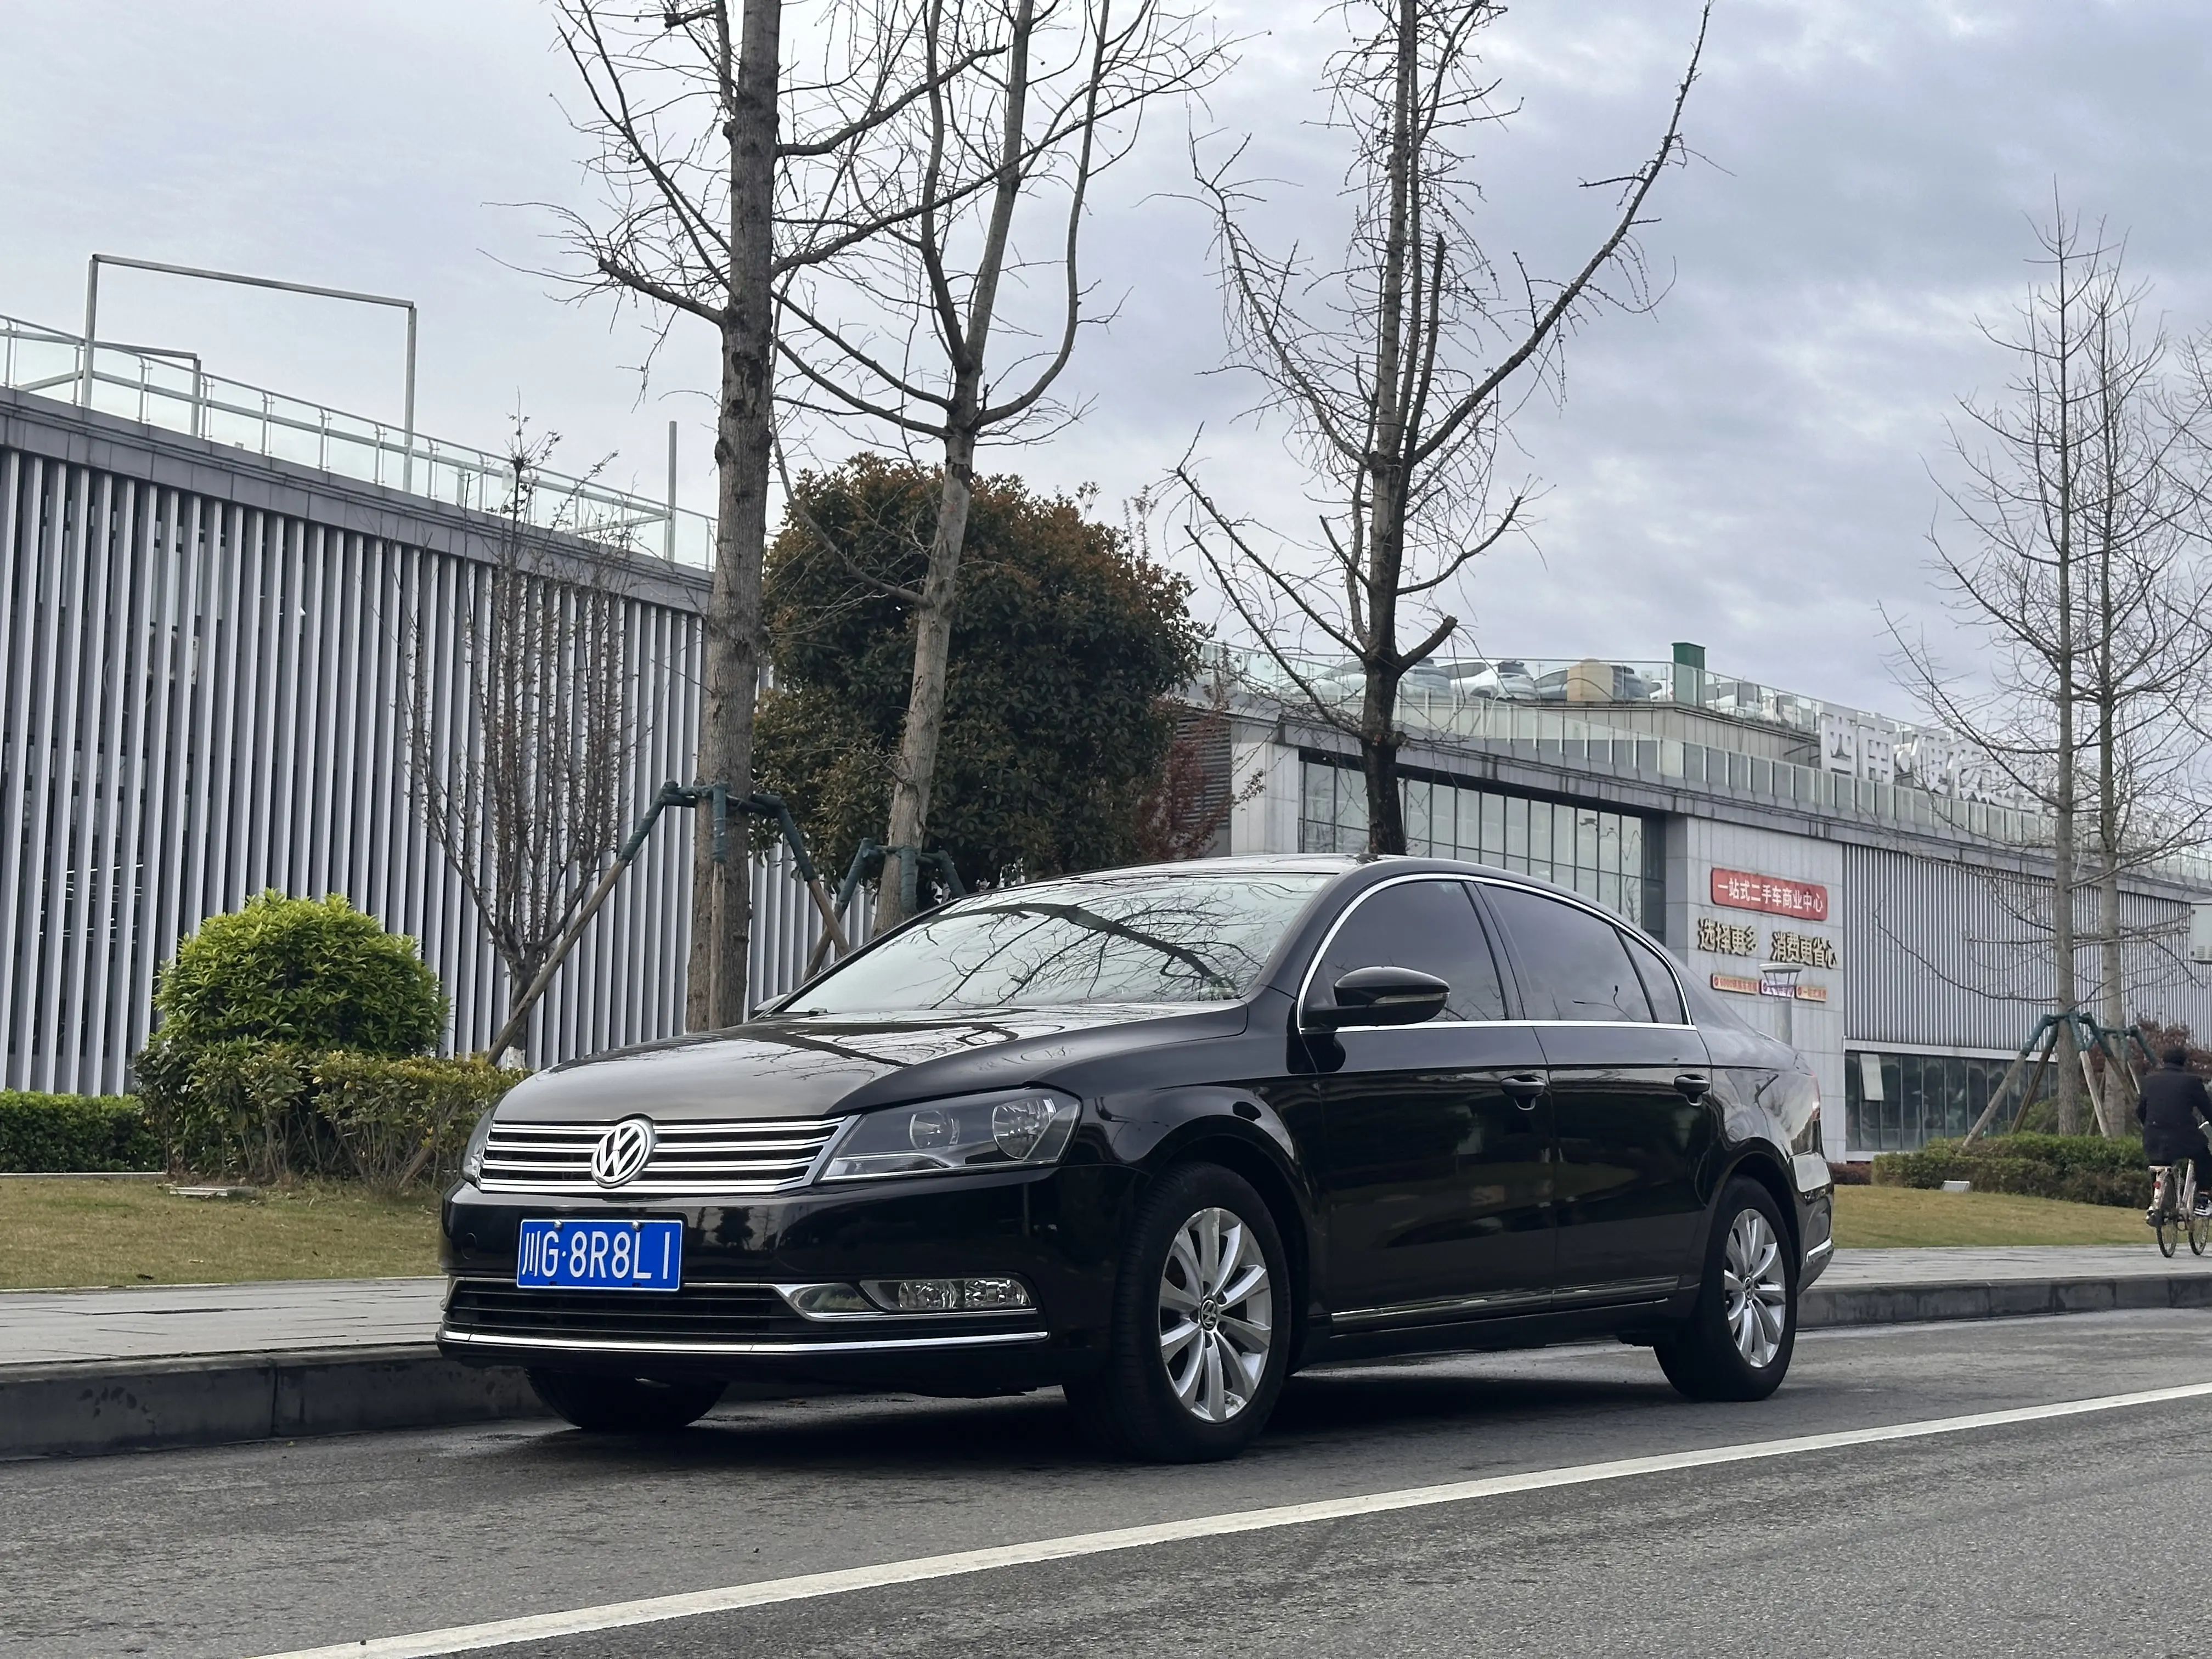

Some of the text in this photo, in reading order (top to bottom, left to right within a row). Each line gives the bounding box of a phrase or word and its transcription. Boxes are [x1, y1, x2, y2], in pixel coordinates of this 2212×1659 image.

[1717, 877, 1824, 913] 一站式二手车商业中心
[1698, 918, 1838, 969] 选择更多 消费更省心
